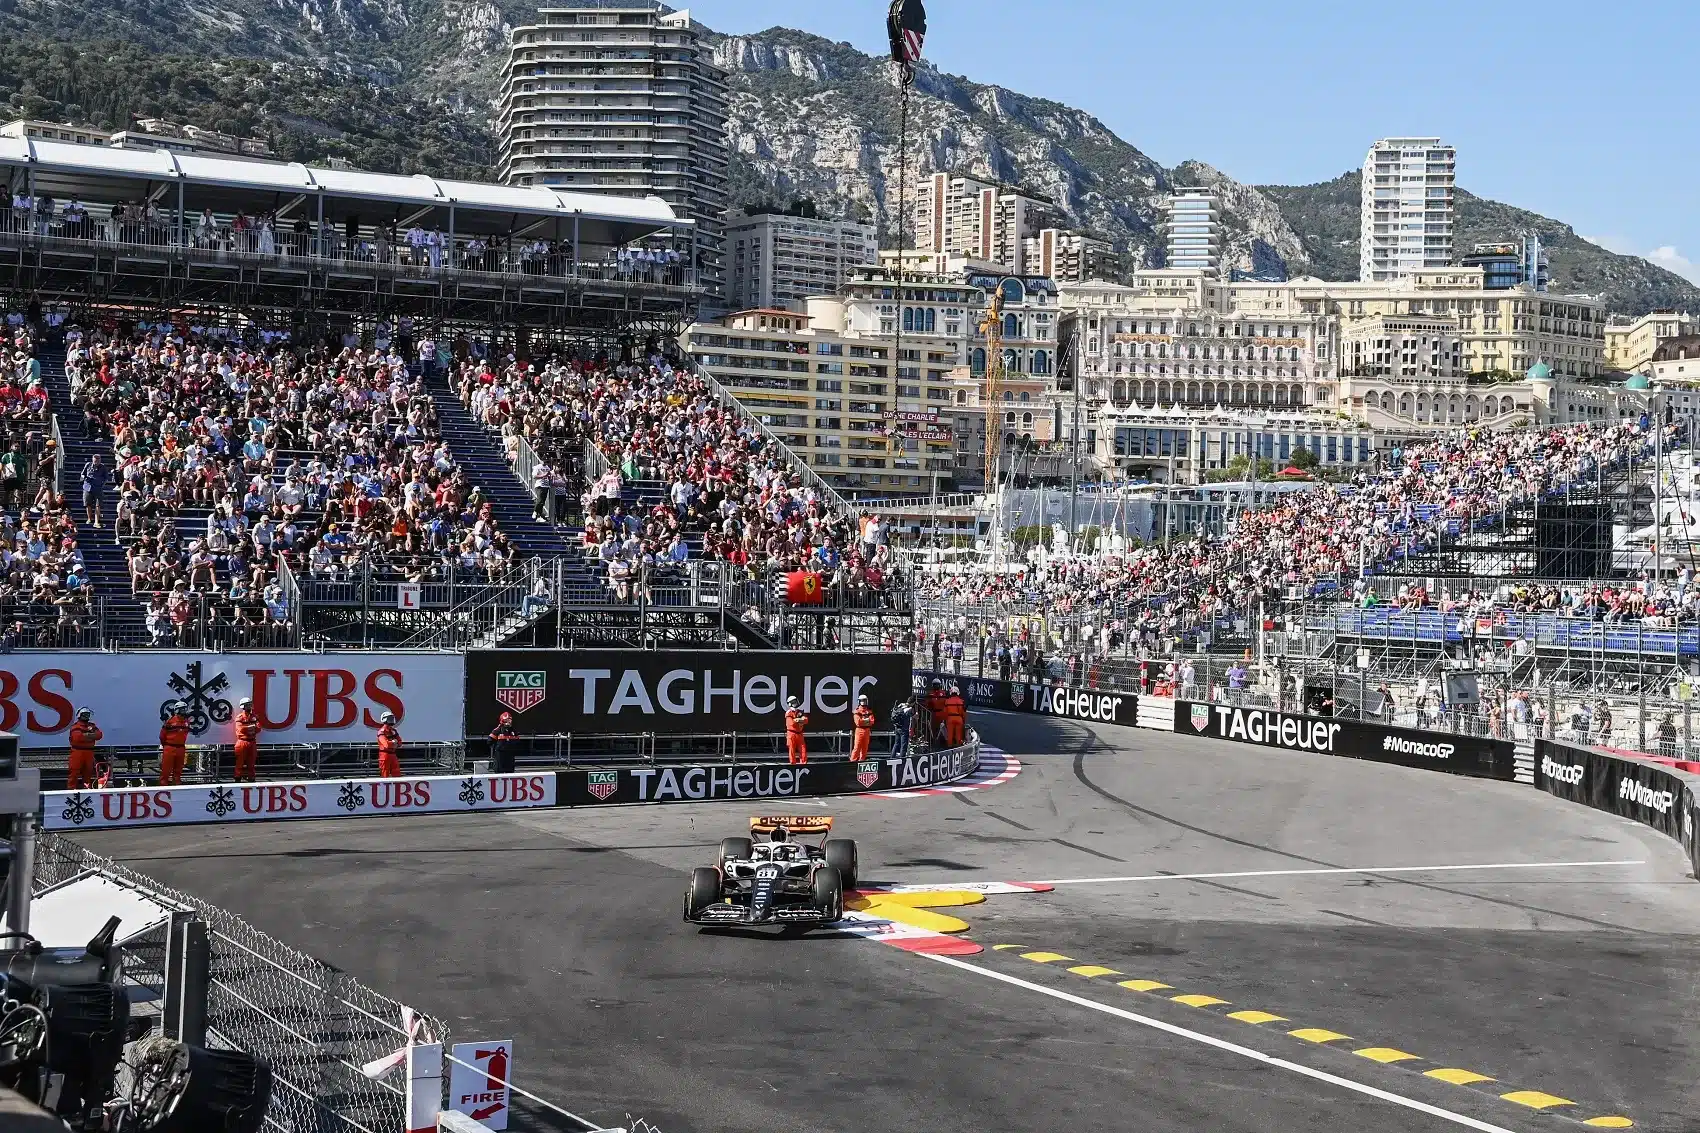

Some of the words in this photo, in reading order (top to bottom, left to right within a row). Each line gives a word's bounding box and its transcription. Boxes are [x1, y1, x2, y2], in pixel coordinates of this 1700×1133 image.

[907, 412, 935, 421] CHARLIE
[404, 592, 413, 606] L
[500, 673, 541, 687] TAG
[976, 683, 994, 697] MSC
[245, 668, 405, 732] UBS
[498, 690, 543, 710] HEUER
[1192, 704, 1208, 717] TAG
[1383, 735, 1455, 759] #MonacoGP
[860, 763, 877, 772] TAG
[591, 773, 616, 783] TAG
[369, 780, 431, 809] UBS
[487, 776, 545, 803] UBS
[589, 783, 617, 799] HEUER
[100, 790, 173, 821] UBS
[240, 785, 308, 815] UBS
[461, 1091, 505, 1105] FIRE
